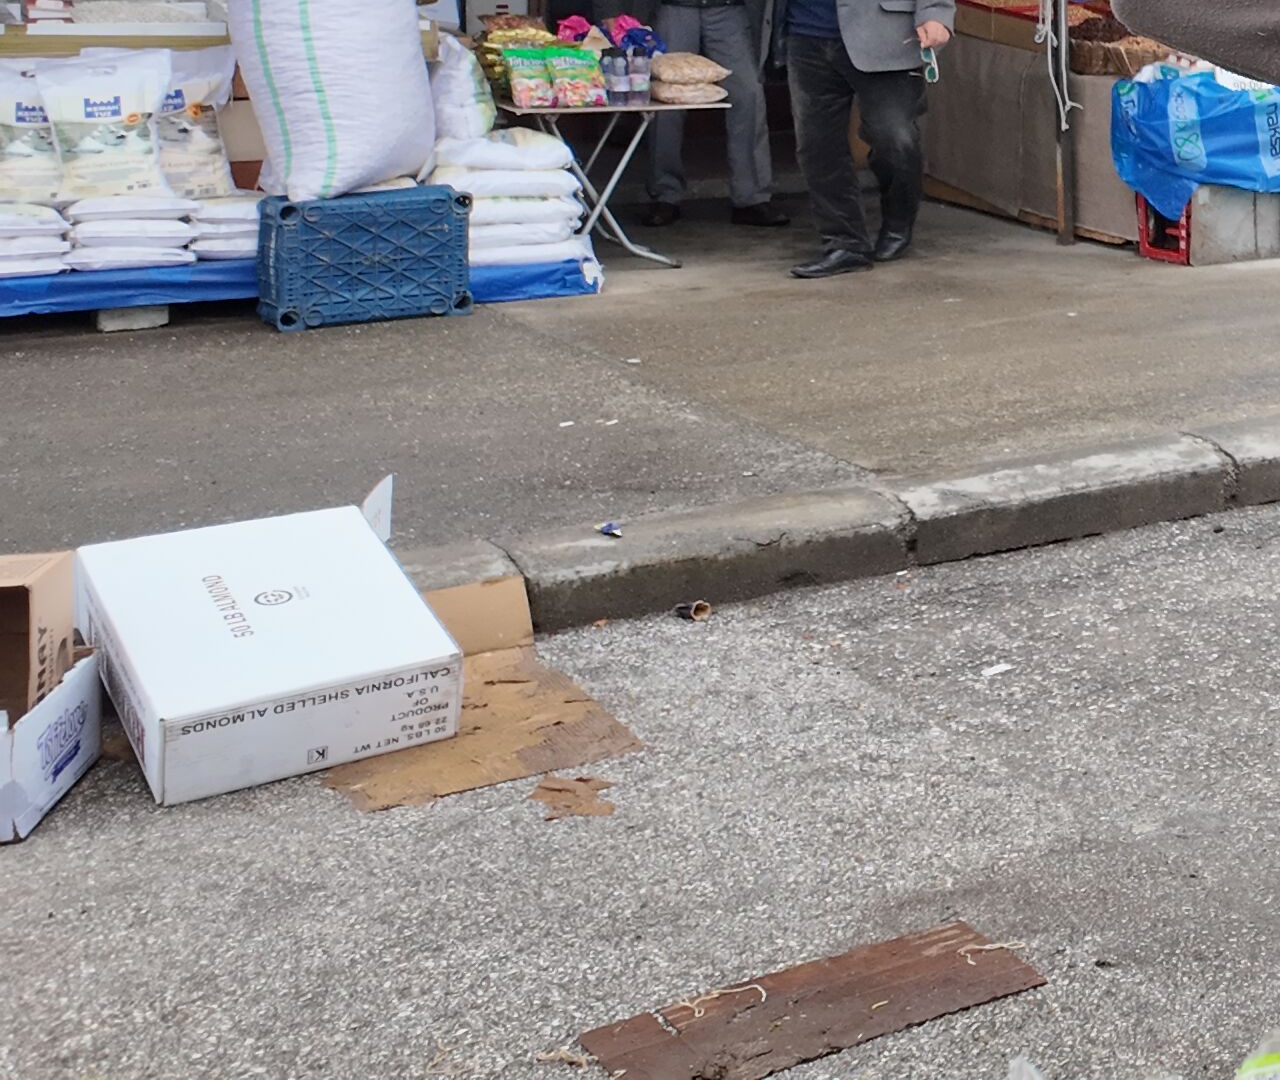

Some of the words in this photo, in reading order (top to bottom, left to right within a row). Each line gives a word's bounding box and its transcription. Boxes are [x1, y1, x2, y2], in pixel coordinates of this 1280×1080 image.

[202, 575, 241, 612] ALMOND
[223, 612, 247, 625] LB
[230, 625, 254, 638] 50
[355, 667, 451, 696] CALIFORNIA
[273, 688, 350, 714] SHELLED
[413, 697, 429, 707] OF
[390, 701, 449, 722] PRODUCT
[181, 706, 268, 736] ALMONDS
[352, 744, 371, 754] WT
[376, 737, 399, 748] NET
[315, 748, 326, 761] K
